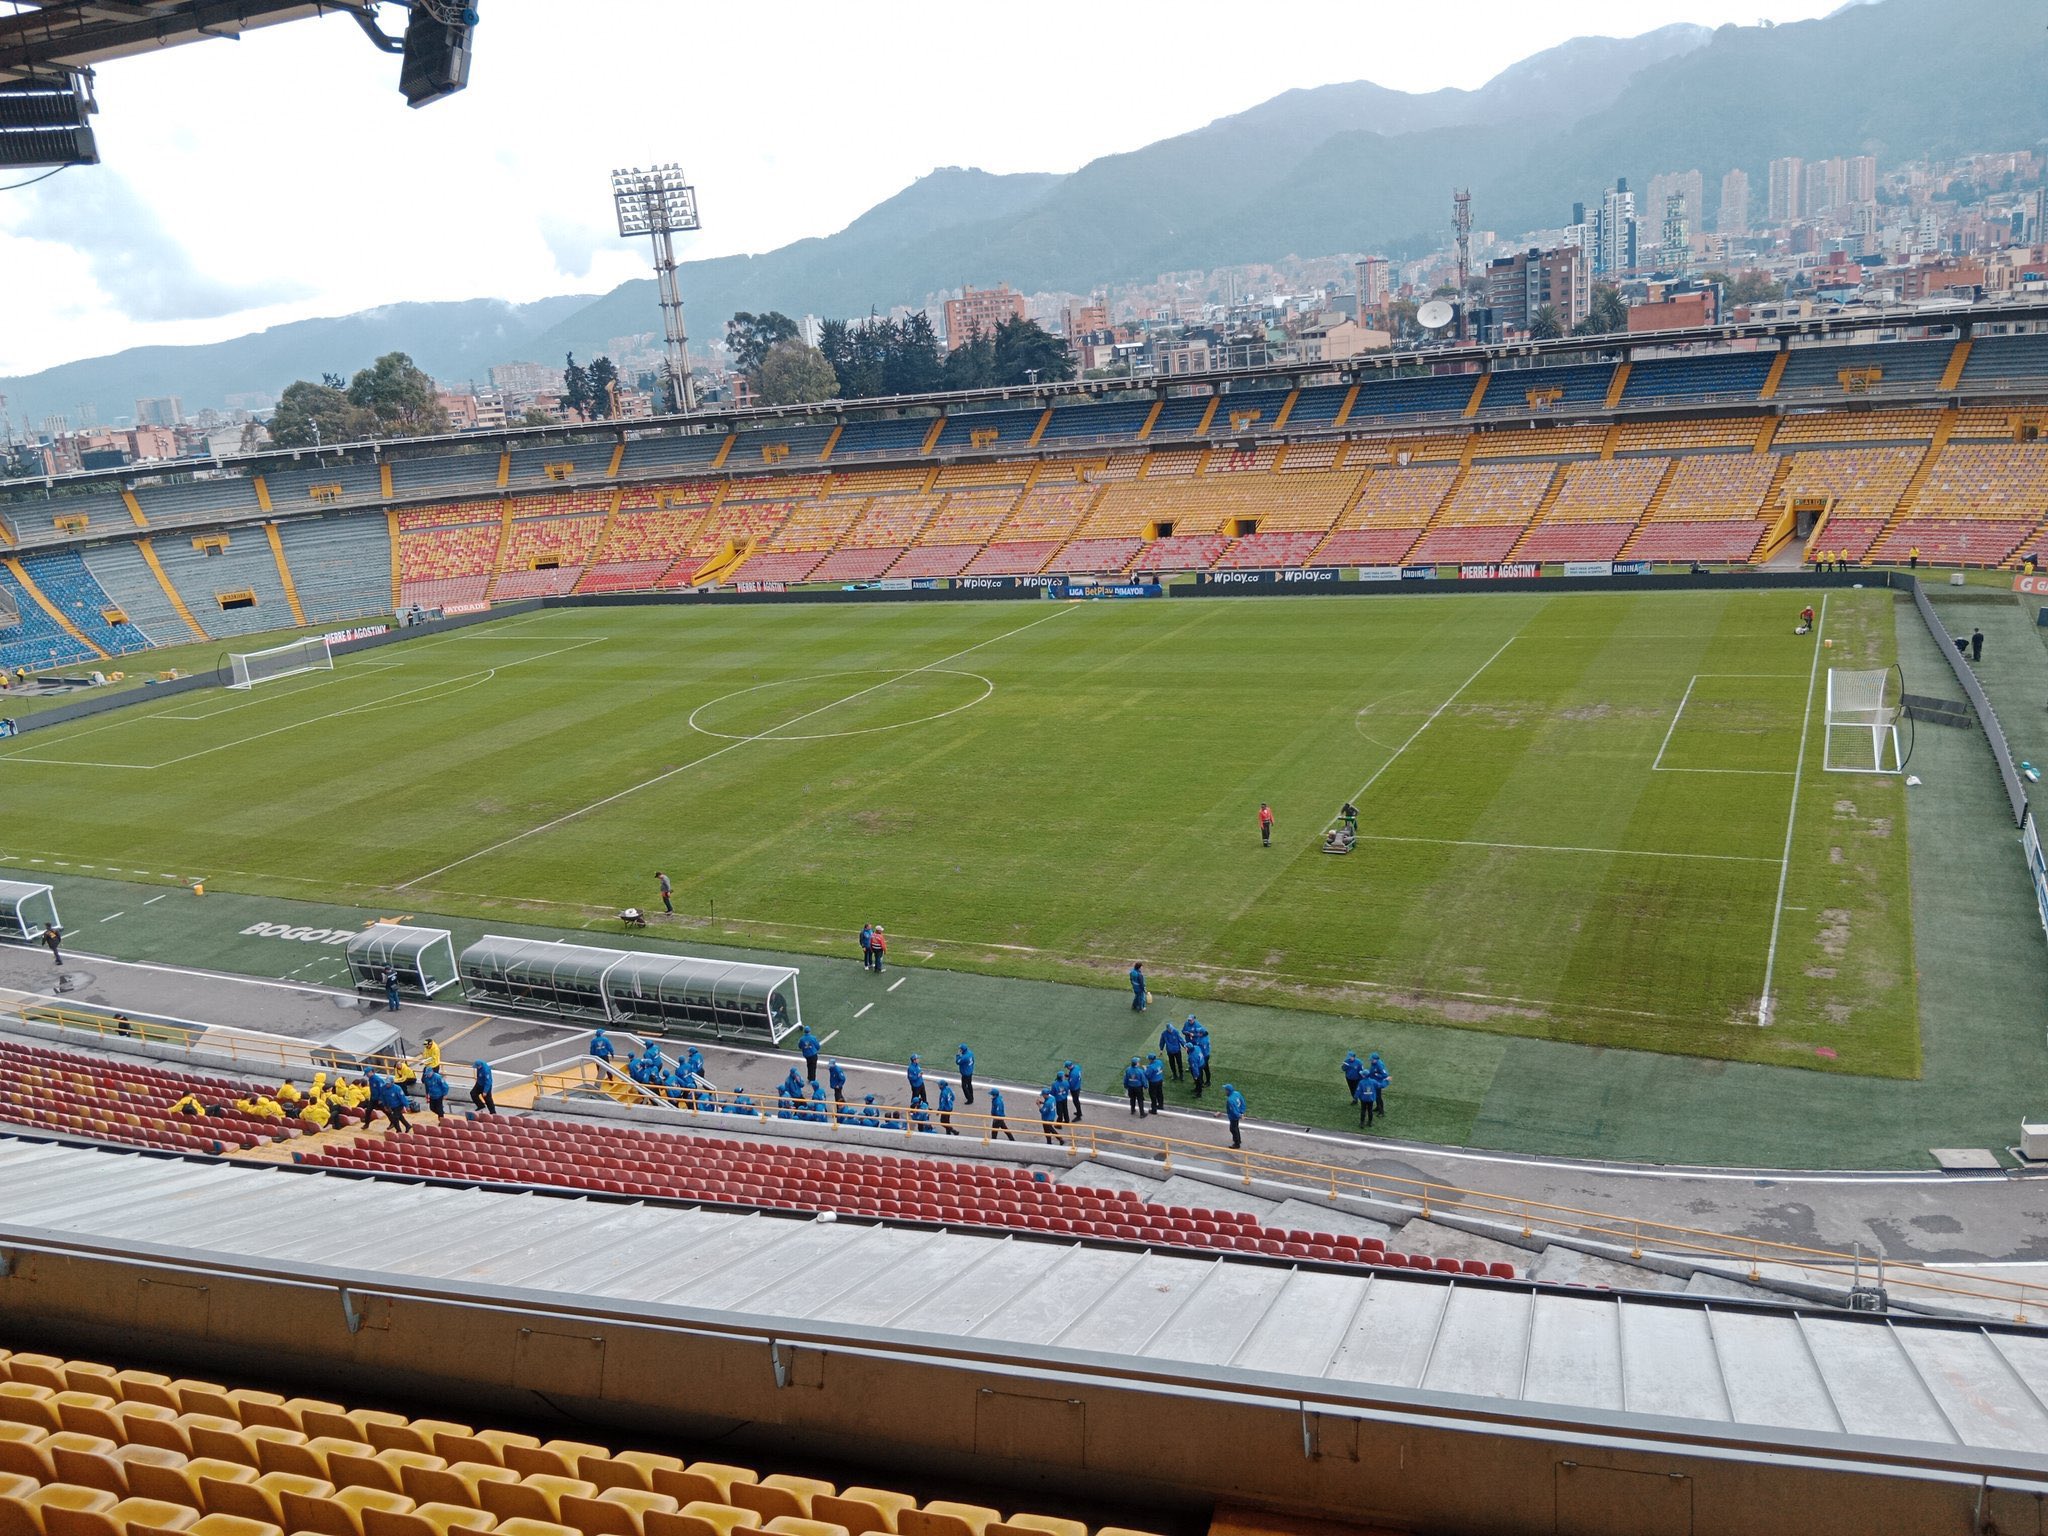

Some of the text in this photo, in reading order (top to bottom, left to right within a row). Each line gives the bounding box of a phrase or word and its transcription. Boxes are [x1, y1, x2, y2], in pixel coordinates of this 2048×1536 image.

[1402, 569, 1425, 579] ANDINA
[1461, 565, 1488, 579] PIERRE
[1498, 564, 1536, 578] AGOSTINY
[1613, 564, 1639, 573] ANDINA
[1214, 572, 1260, 584] Wplay.co
[1285, 570, 1332, 582] Wplay.co
[963, 578, 1003, 589] Wplay.co
[1069, 588, 1084, 596] LIGA
[1114, 587, 1144, 595] DIMAYOR
[325, 631, 347, 645] PIERRE
[354, 624, 387, 640] AGOSTINY
